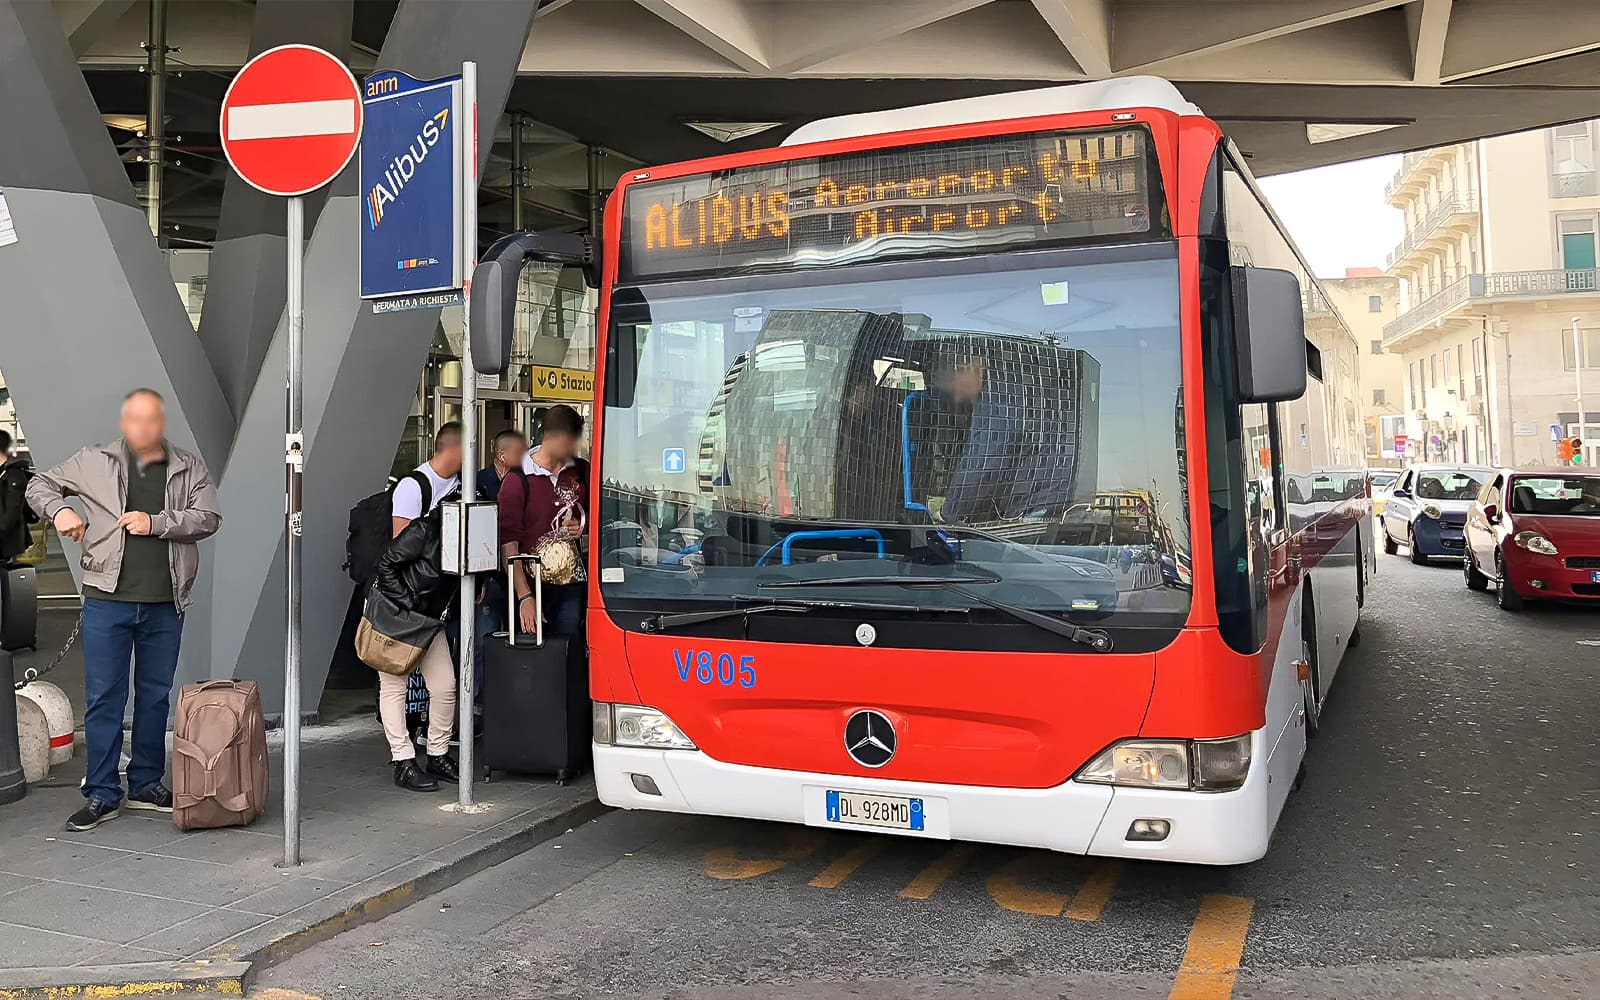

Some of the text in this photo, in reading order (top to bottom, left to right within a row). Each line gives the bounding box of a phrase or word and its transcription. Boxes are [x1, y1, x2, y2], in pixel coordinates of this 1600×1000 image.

[367, 76, 398, 97] anm
[375, 119, 440, 218] Alibus
[646, 152, 1097, 249] ALIBUS Aeroporto
[855, 190, 1057, 239] Airport
[376, 299, 411, 310] FERMATA
[419, 294, 458, 305] RICHIESTA
[672, 649, 757, 688] V805
[840, 798, 858, 817] DL
[863, 801, 908, 822] 928MD
